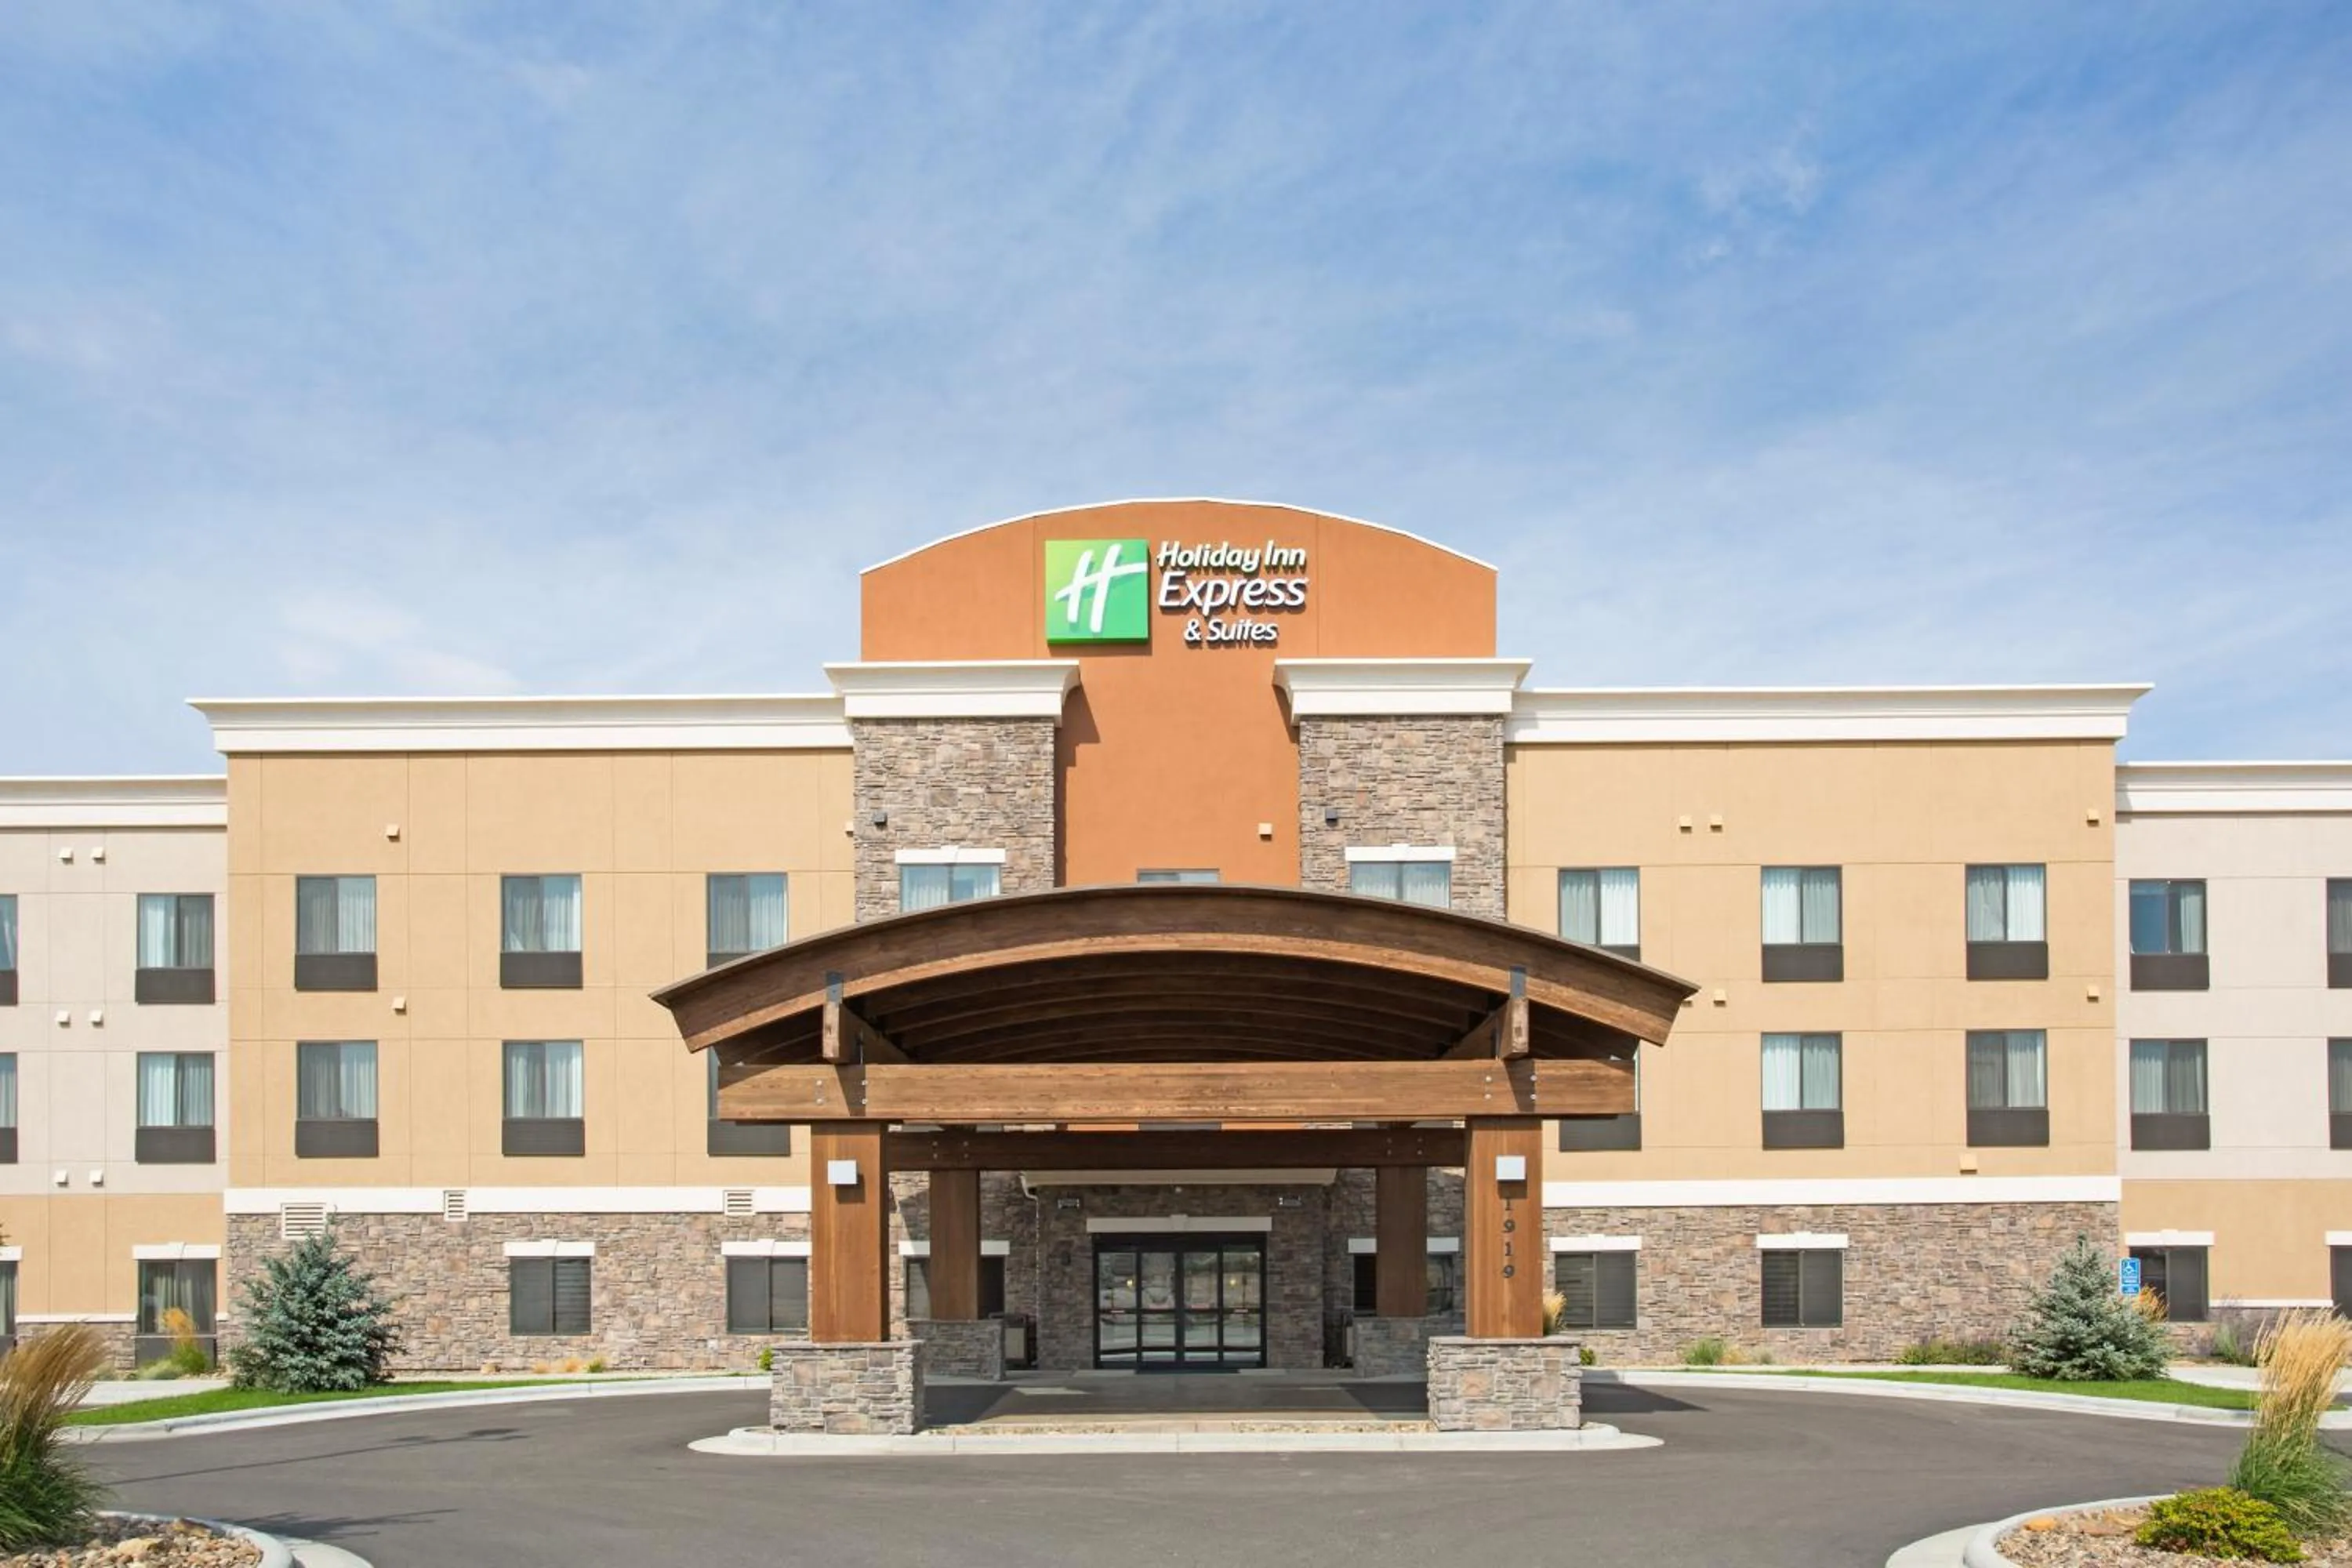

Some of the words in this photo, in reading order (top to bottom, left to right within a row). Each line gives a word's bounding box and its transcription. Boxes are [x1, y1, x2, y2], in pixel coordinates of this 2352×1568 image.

[1156, 539, 1260, 572] Holiday
[1265, 539, 1306, 566] Inn
[1158, 571, 1307, 616] Express
[1184, 619, 1202, 641] &
[1207, 619, 1279, 641] Suites
[1502, 1197, 1516, 1279] 1919
